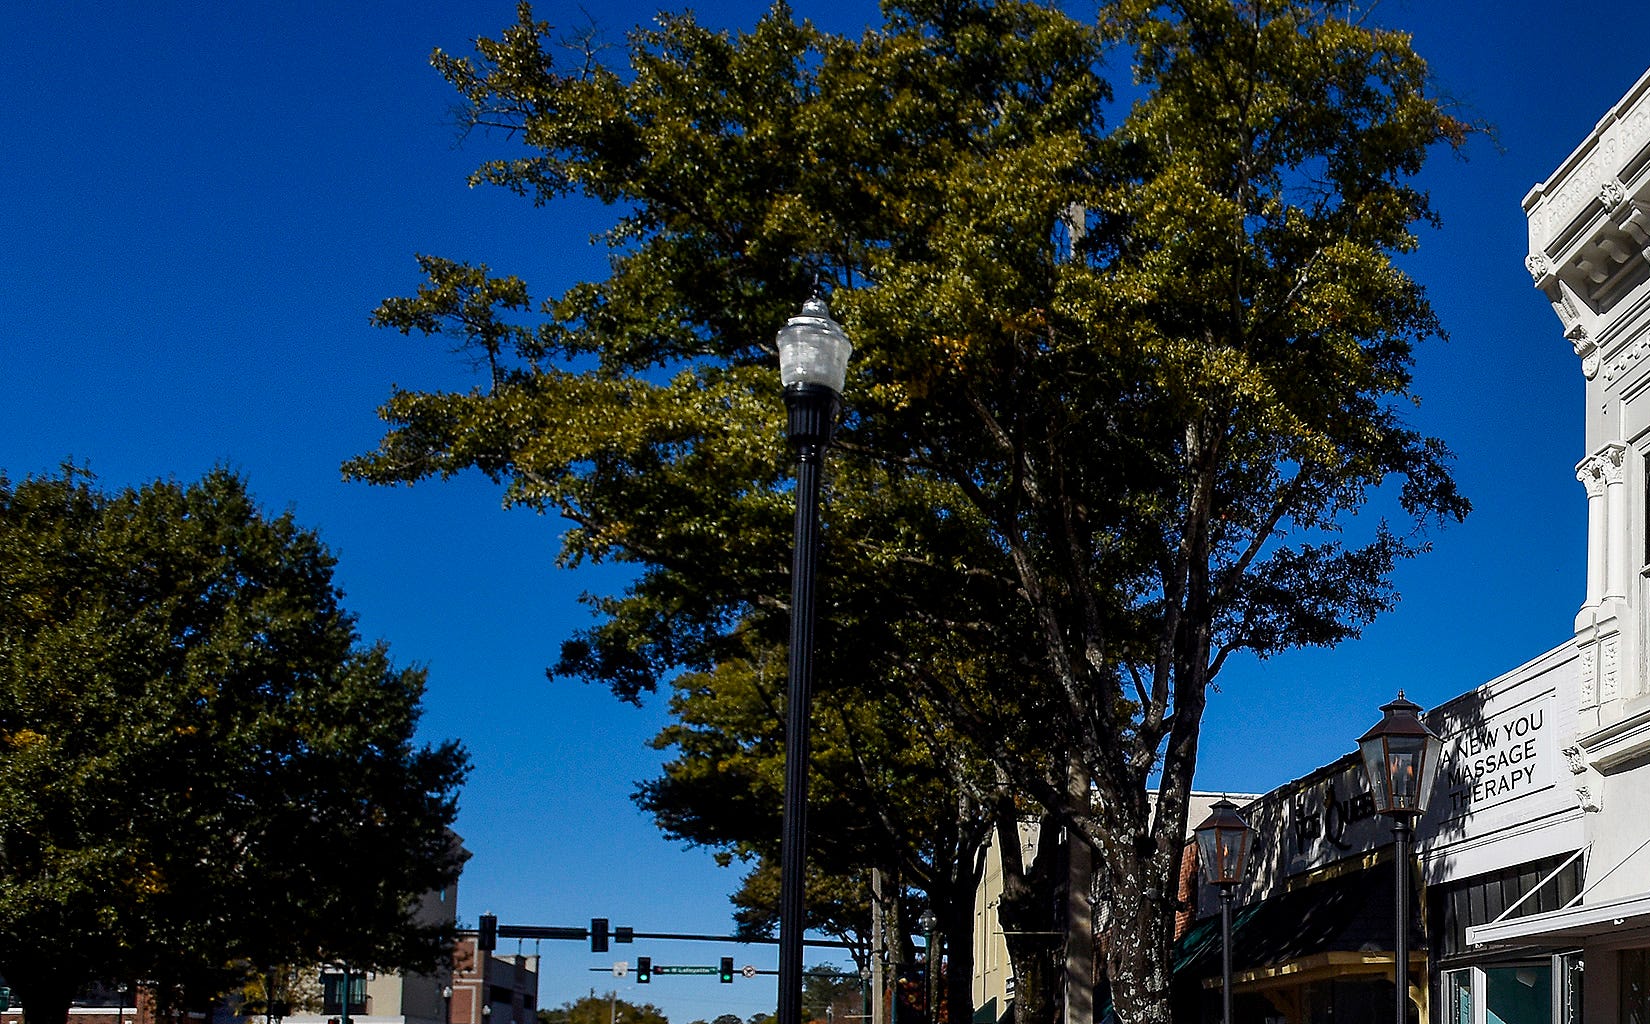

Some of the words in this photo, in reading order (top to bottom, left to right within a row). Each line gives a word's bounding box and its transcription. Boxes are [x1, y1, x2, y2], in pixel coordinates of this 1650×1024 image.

[1441, 750, 1453, 769] A
[1456, 727, 1499, 761] NEW
[1503, 709, 1544, 741] YOU
[1448, 738, 1537, 788] MASSAGE
[1449, 763, 1536, 810] THERAPY
